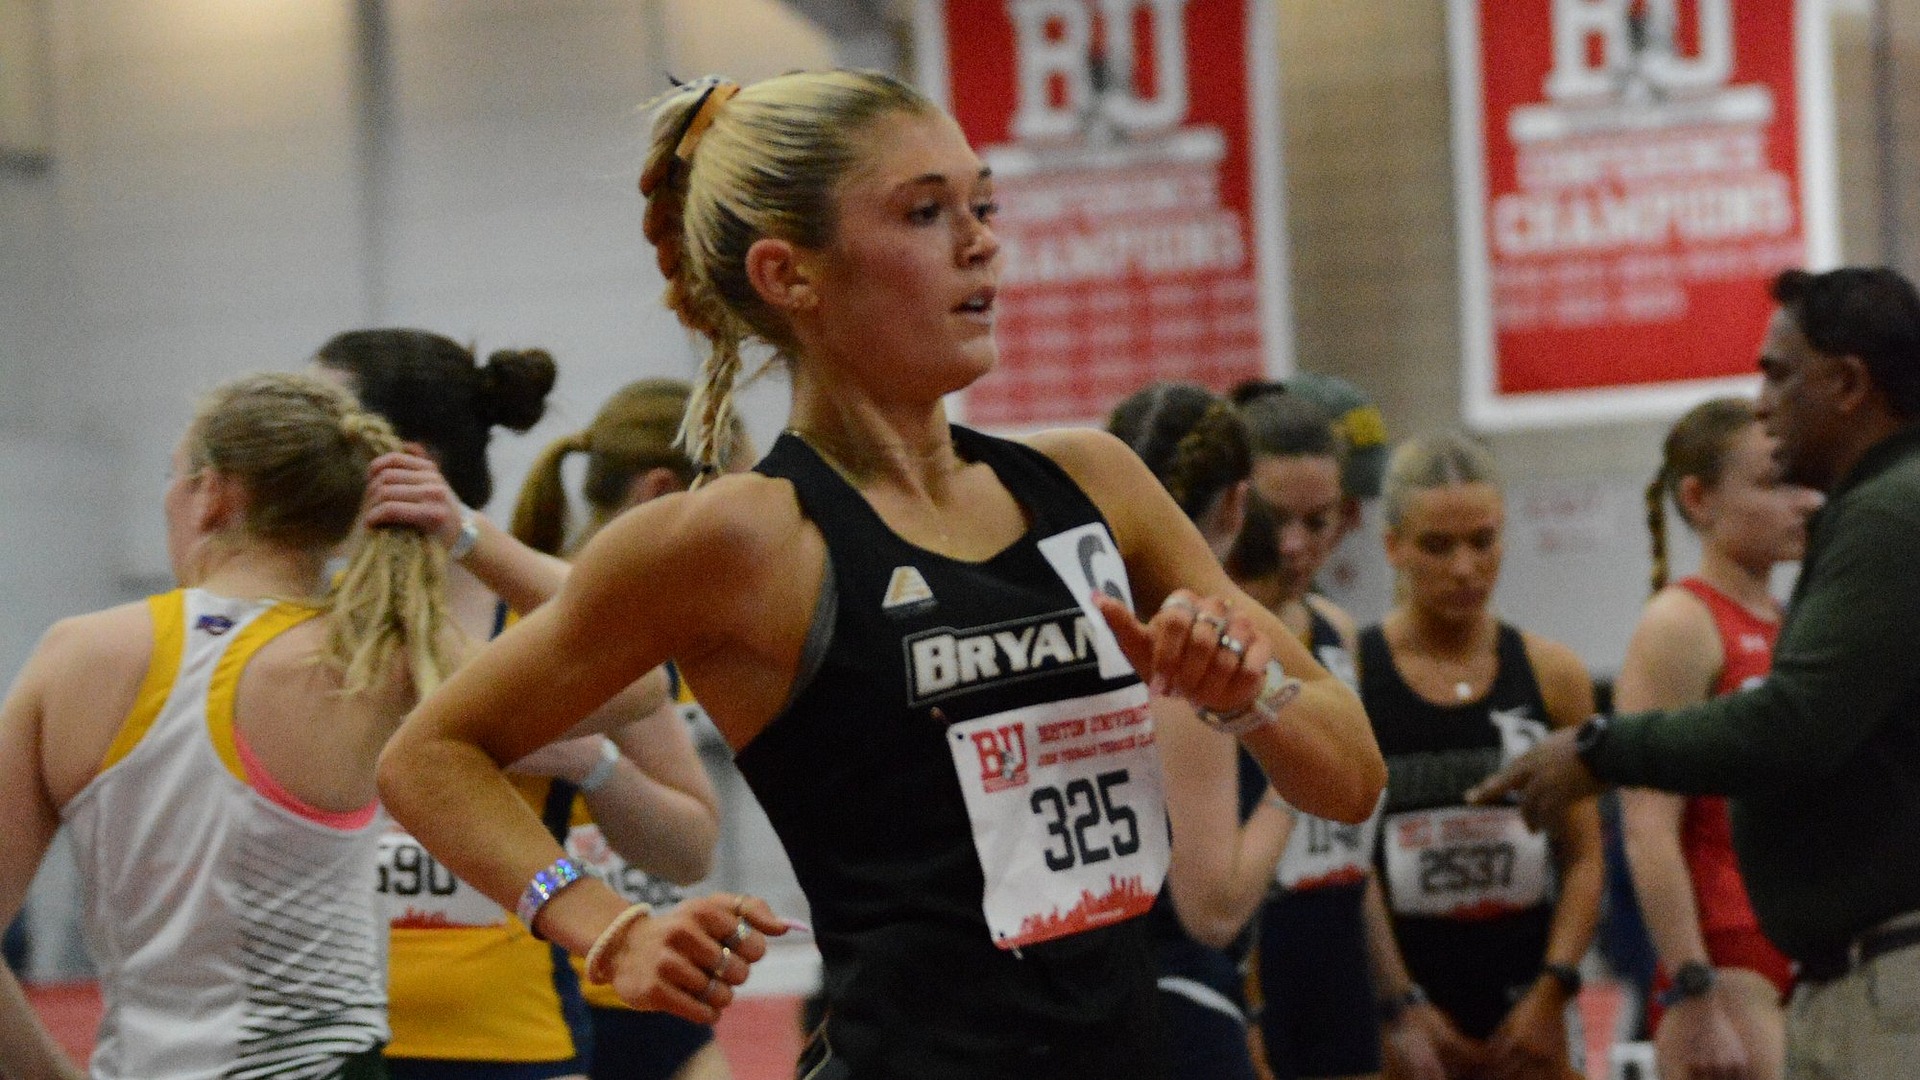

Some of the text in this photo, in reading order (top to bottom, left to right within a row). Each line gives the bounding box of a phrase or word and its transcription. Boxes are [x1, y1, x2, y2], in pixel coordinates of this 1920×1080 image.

[1011, 0, 1191, 138] BU
[1546, 0, 1736, 98] BU
[1000, 212, 1246, 284] HAMPIONS
[1496, 171, 1795, 259] CHAMPIONS
[912, 616, 1096, 698] BRYAN
[970, 721, 1028, 781] BU
[1029, 769, 1141, 872] 325
